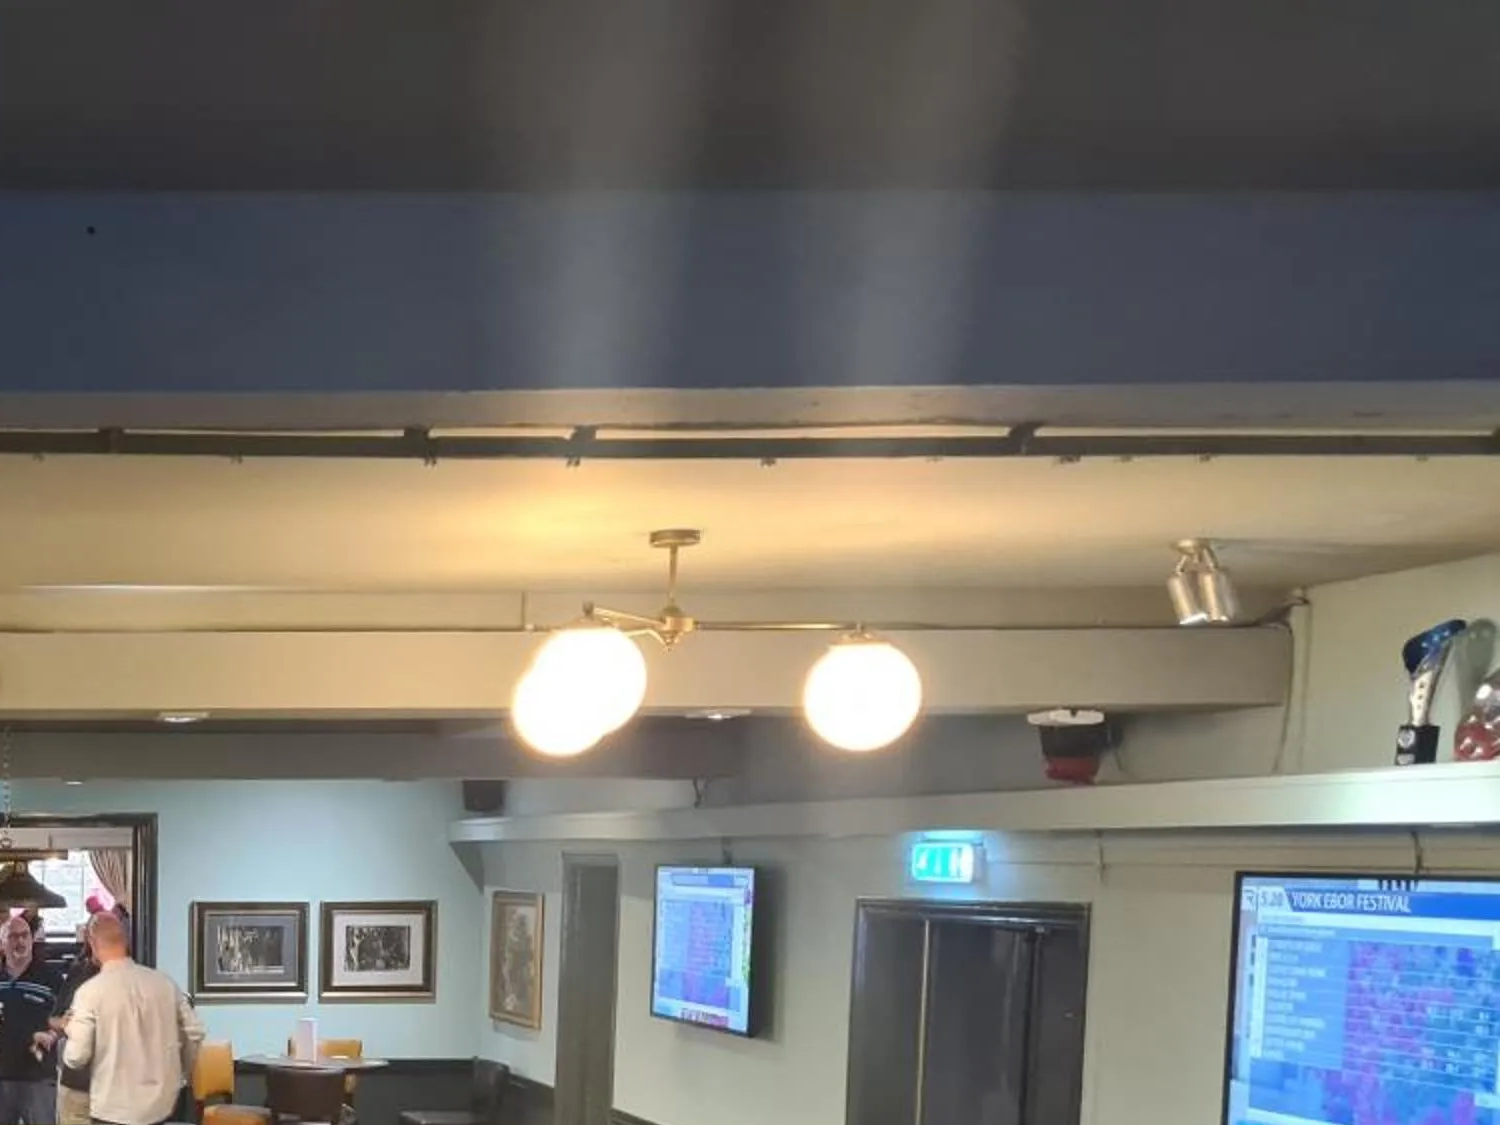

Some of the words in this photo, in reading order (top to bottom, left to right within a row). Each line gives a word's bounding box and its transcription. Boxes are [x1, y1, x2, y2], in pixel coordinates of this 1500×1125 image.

[1291, 891, 1323, 910] YORK
[1323, 892, 1356, 911] EBOR
[1357, 893, 1412, 914] FESTIVAL
